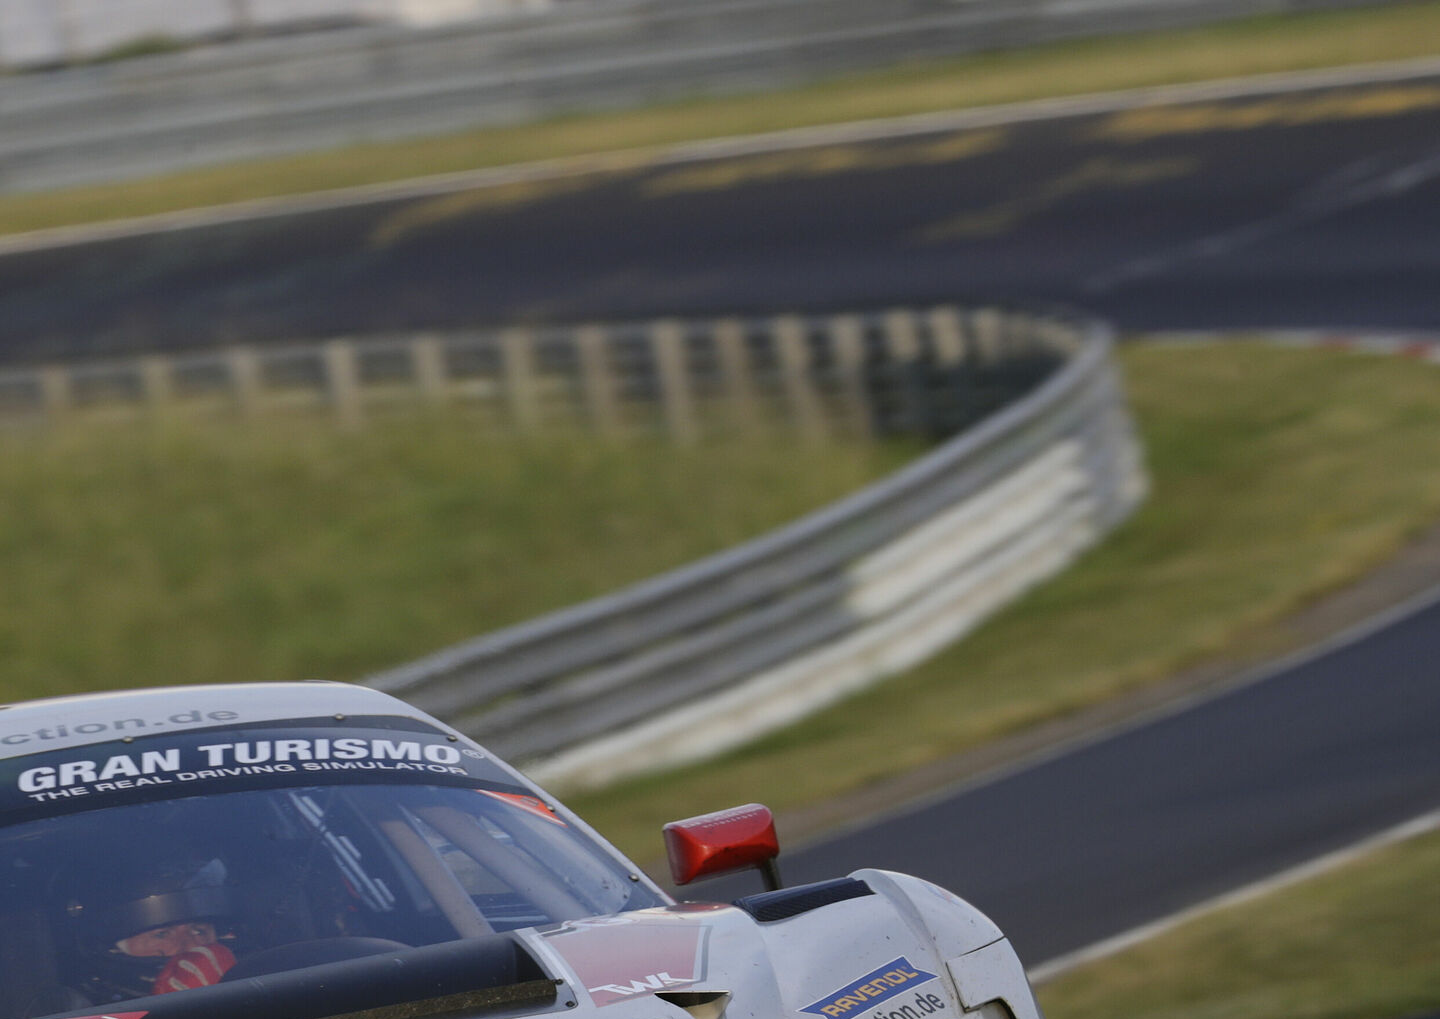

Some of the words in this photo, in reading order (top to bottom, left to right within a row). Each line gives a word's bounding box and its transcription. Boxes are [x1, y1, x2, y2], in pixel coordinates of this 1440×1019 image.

[17, 748, 182, 793] GRAN
[197, 738, 462, 768] TURISMO
[29, 785, 90, 802] THE
[94, 776, 172, 793] REAL
[176, 761, 296, 782] DRIVING
[303, 760, 468, 776] SIMULATOR
[820, 967, 920, 1018] RAVENOL
